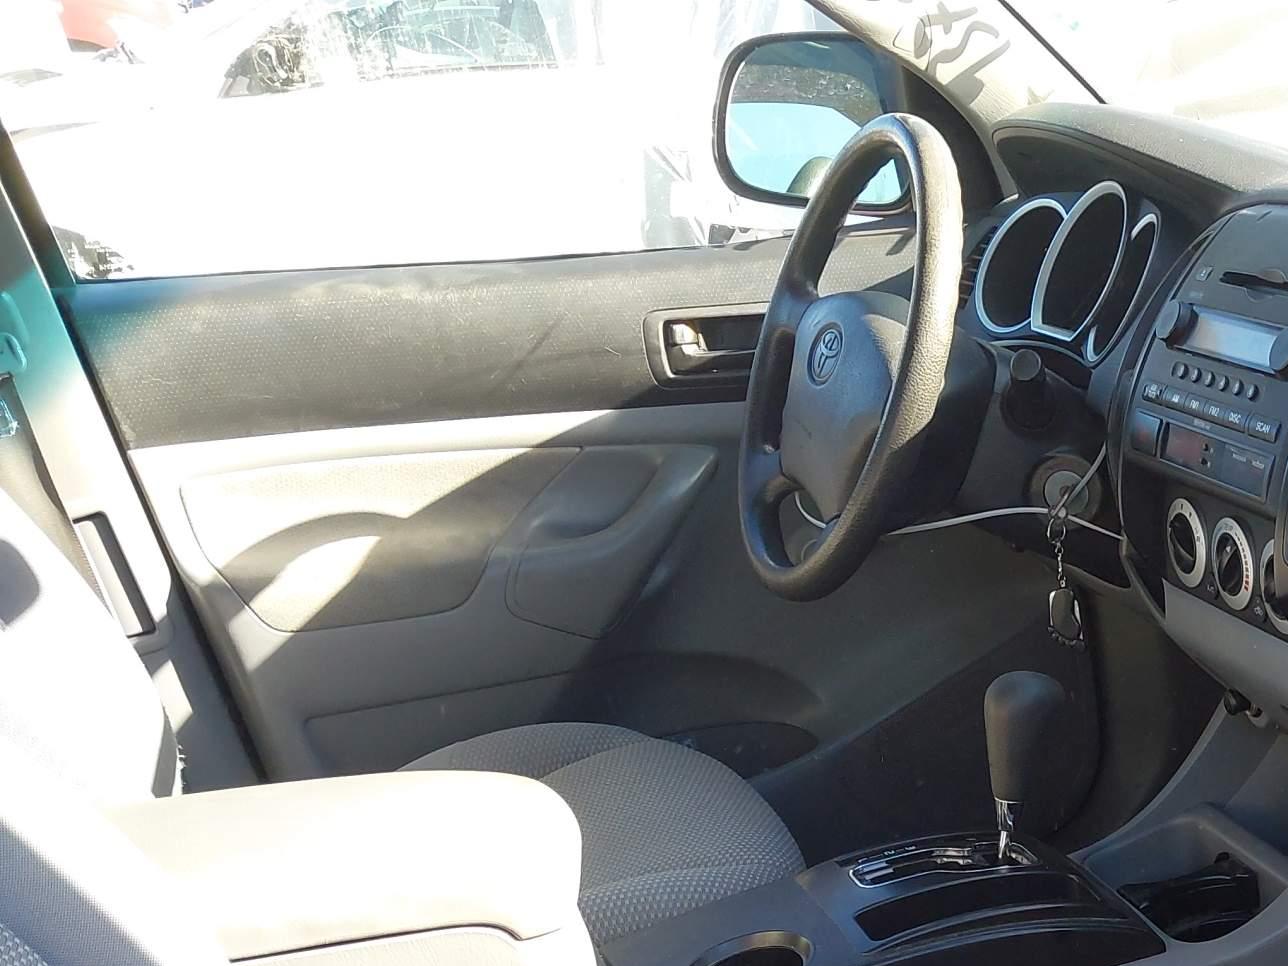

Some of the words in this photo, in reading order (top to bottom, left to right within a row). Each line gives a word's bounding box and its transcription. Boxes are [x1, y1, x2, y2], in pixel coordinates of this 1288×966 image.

[1208, 405, 1220, 417] FM2
[1228, 411, 1242, 424] DISC
[1255, 421, 1271, 433] SCAN
